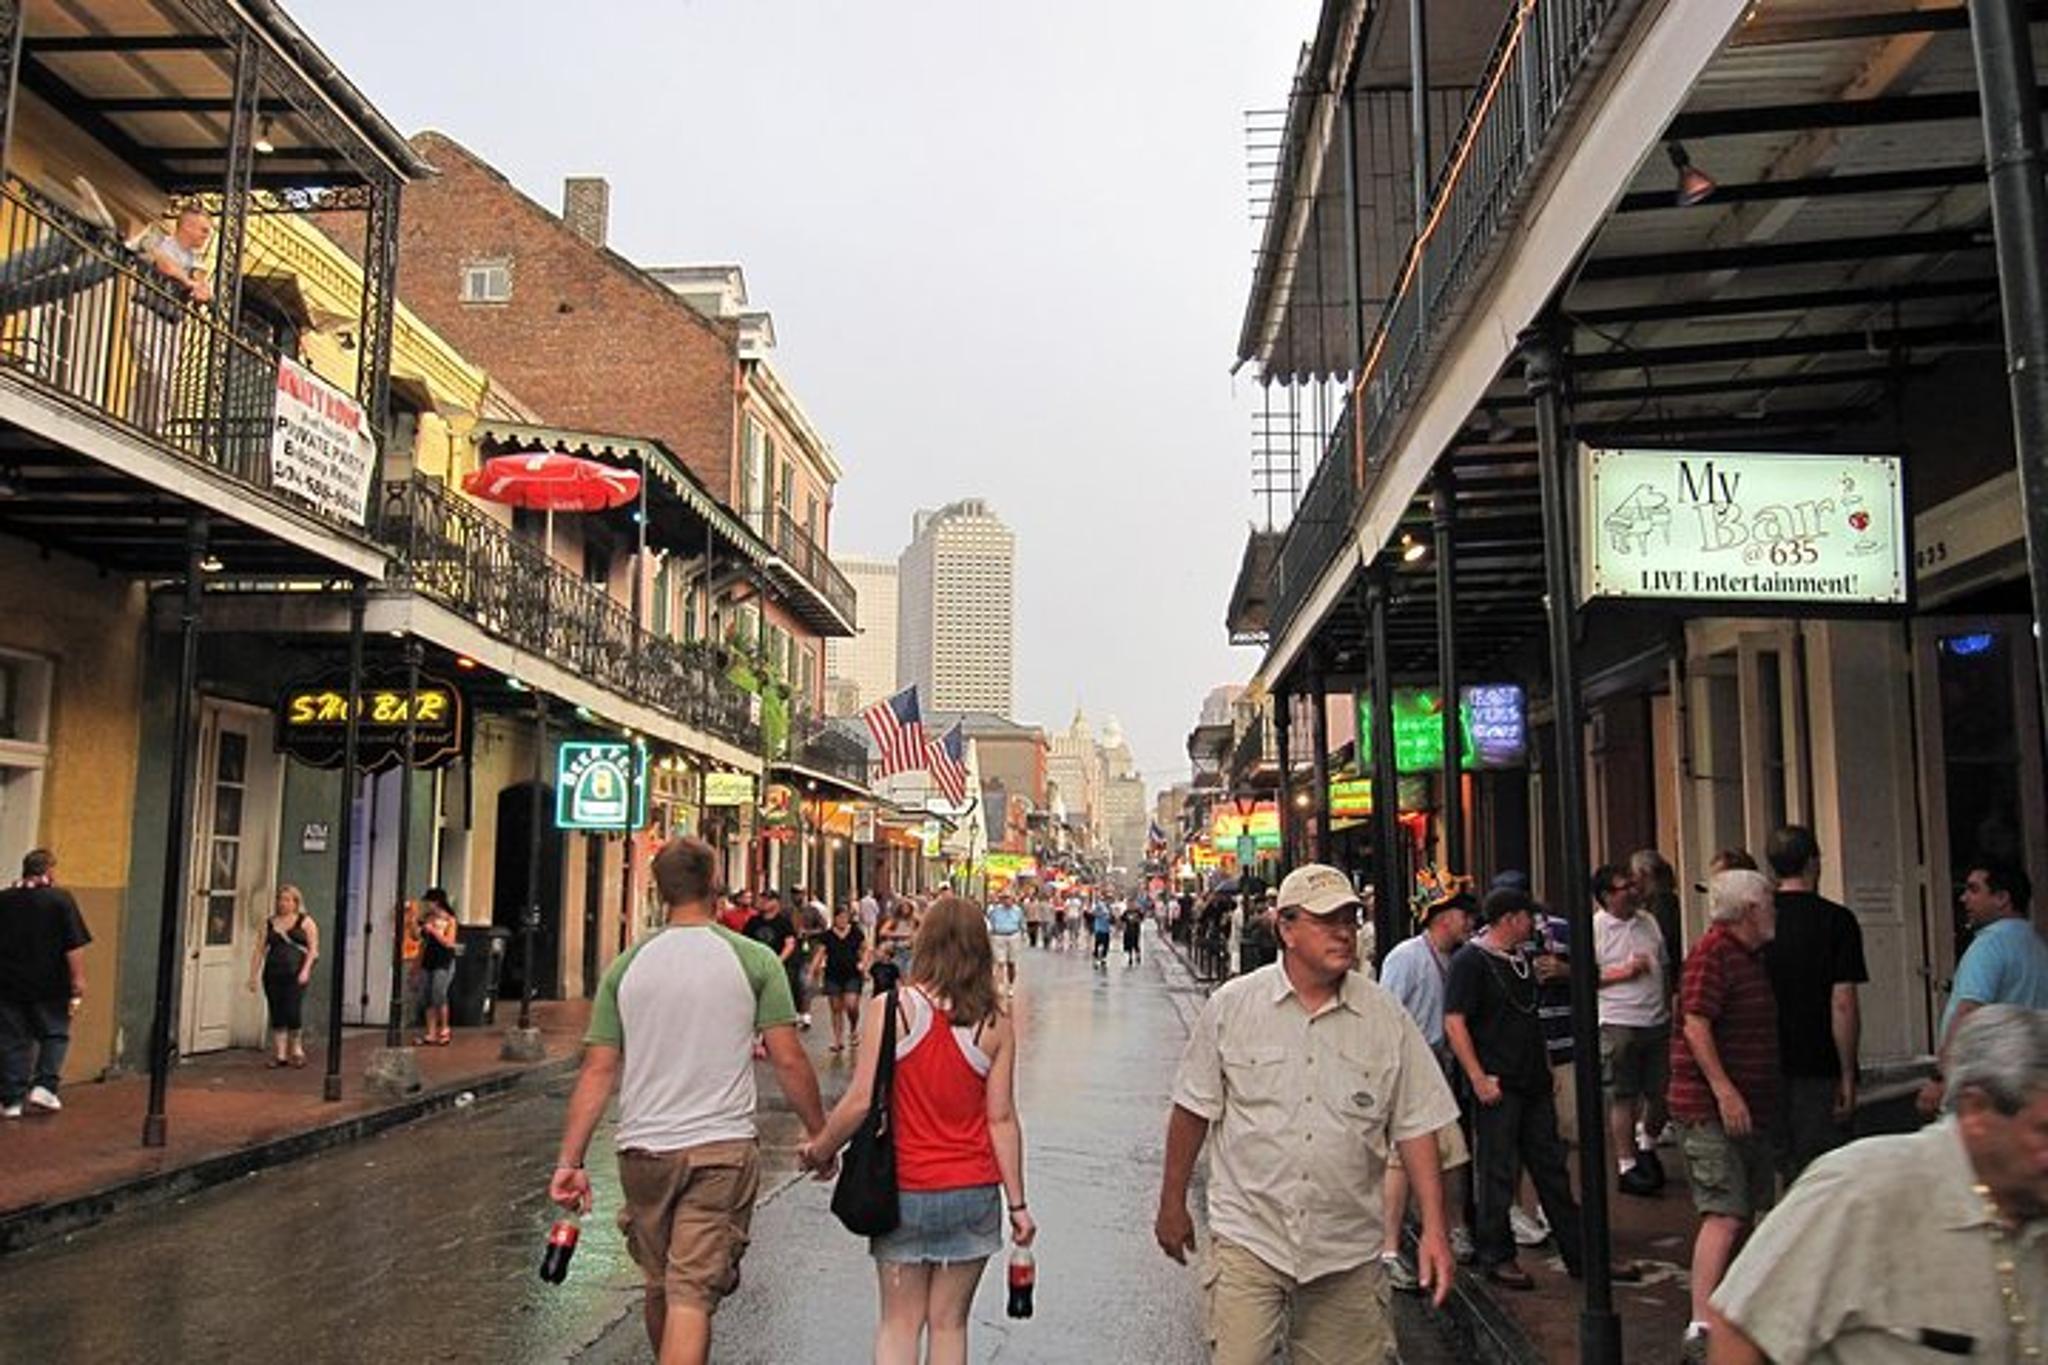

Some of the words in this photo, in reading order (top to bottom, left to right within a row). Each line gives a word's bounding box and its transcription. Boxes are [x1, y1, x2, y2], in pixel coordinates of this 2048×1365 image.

[1677, 460, 1741, 516] My
[1693, 498, 1836, 551] Bar
[1770, 538, 1819, 567] 635
[1641, 570, 1689, 593] LIVE
[1693, 570, 1859, 595] Entertainment!
[372, 692, 447, 722] BAR
